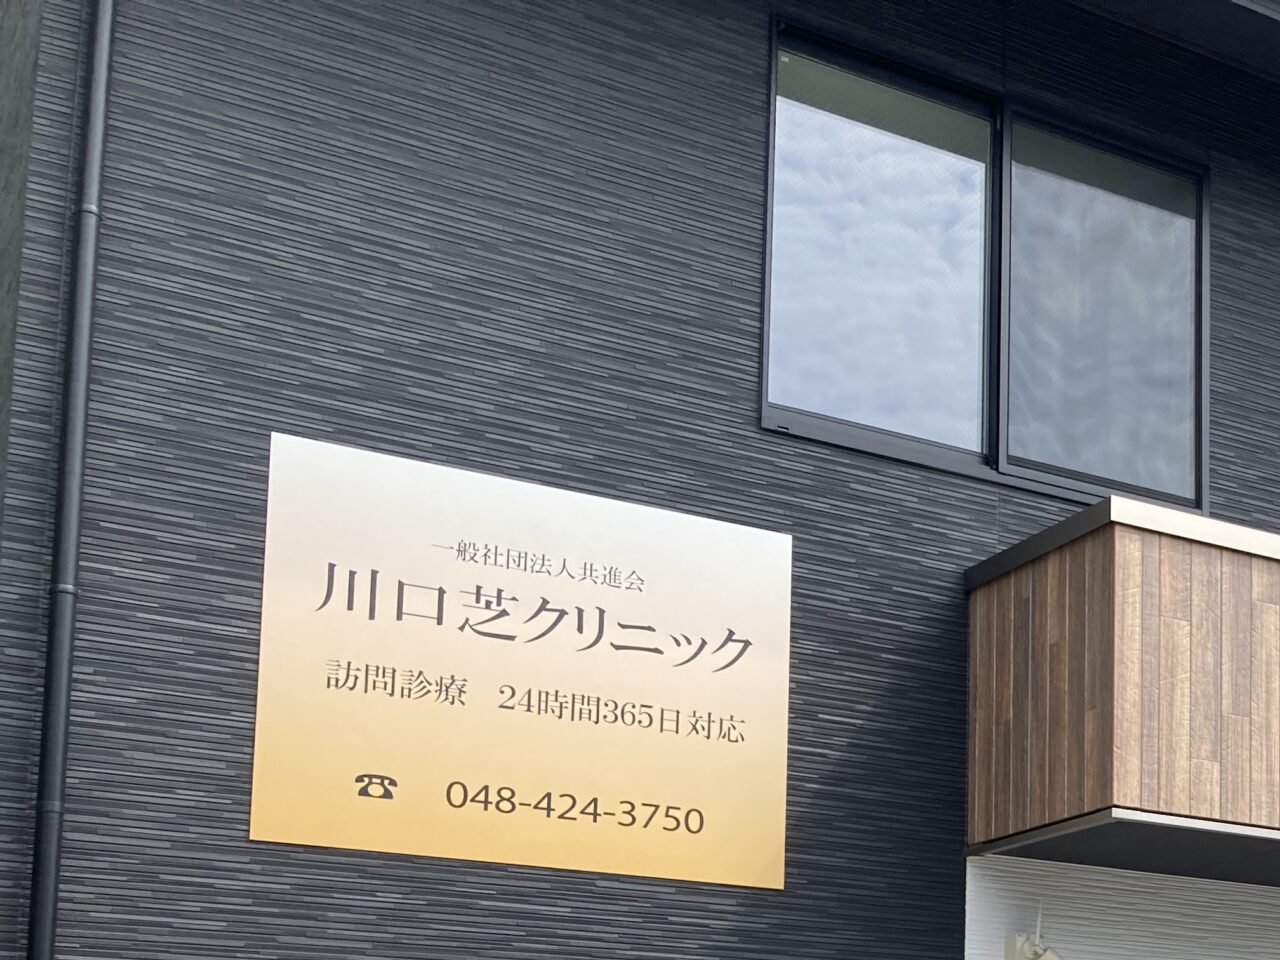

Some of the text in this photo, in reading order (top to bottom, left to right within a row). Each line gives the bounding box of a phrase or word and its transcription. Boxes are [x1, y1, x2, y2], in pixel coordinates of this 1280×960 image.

[431, 539, 646, 593] 一般社団法人共進会
[315, 562, 754, 673] 川口芝クリニック
[326, 660, 747, 744] 訪問診療 24時間365日対応
[445, 780, 705, 835] 048-424-3750
